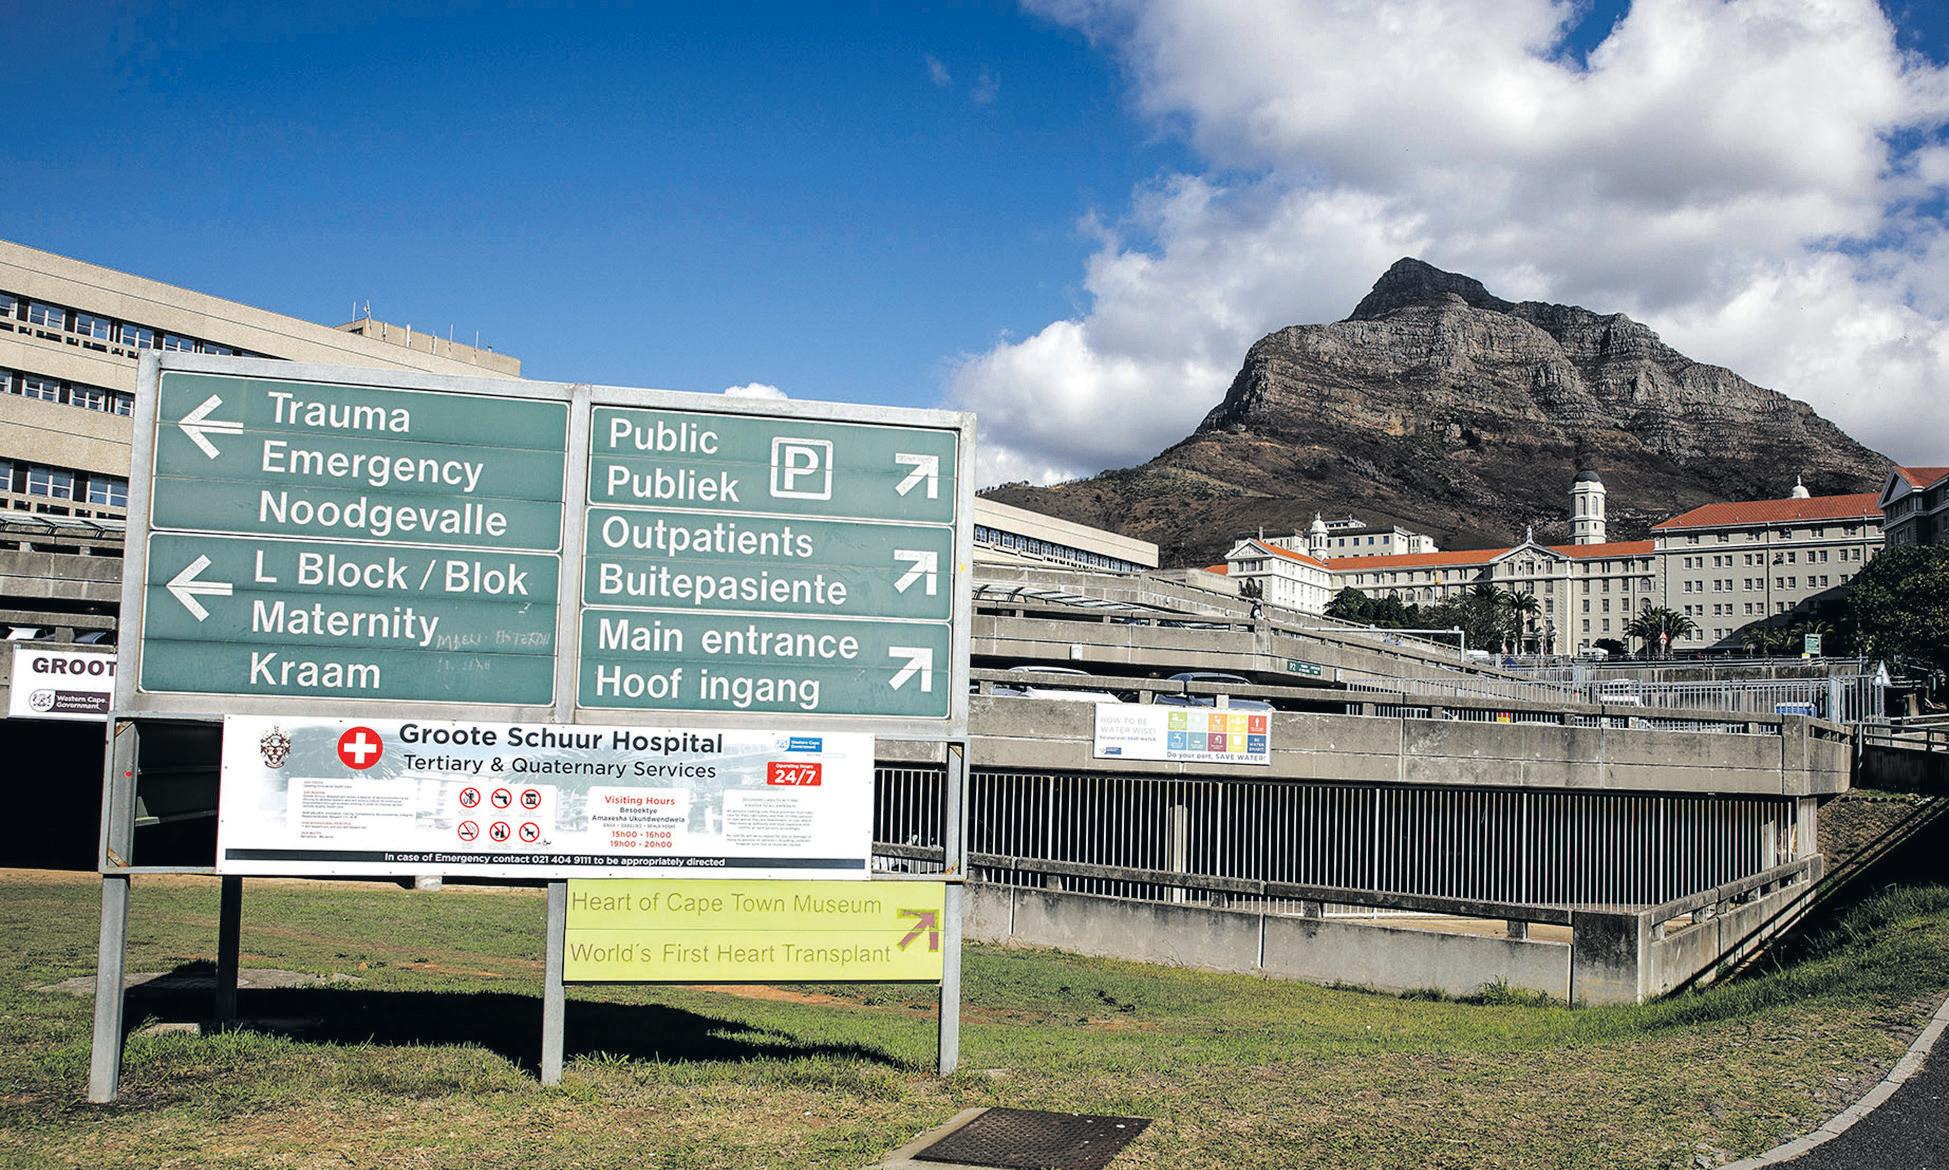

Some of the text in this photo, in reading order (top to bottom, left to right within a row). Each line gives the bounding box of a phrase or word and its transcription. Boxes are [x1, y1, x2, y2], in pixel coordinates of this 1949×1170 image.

[268, 391, 410, 433] Trauma
[609, 417, 719, 454] Public
[261, 440, 484, 493] Emergency
[783, 445, 820, 491] P
[607, 465, 740, 503] Publiek
[259, 490, 508, 537] Noodgevalle
[602, 515, 814, 559] Outpatients
[255, 550, 529, 597] L Block / Blok
[600, 562, 848, 606] Buitepasiente
[252, 600, 440, 647] Maternity
[599, 618, 860, 660] Main entrance
[32, 657, 117, 677] GROOT
[250, 651, 381, 690] Kraam
[56, 695, 86, 703] Western
[596, 664, 820, 710] Hoof ingang
[56, 702, 100, 710] Government
[1100, 726, 1131, 735] WATER
[1101, 716, 1148, 726] HOW TO BE
[399, 723, 723, 756] Groote Schuur Hospital
[404, 754, 717, 778] Tertiary & Quaternary Services
[1236, 754, 1267, 762] WATER!
[774, 769, 817, 786] 24/7
[604, 795, 676, 806] Visiting Hours
[610, 840, 637, 848] 19h00
[644, 840, 673, 848] 20h00
[611, 830, 638, 838] 15h00
[645, 831, 672, 839] 16h00
[384, 852, 726, 868] In case of Emergency contact 021 404 9111 to be appropriately directed
[571, 892, 882, 916] Heart of Cape Town Museum
[663, 943, 709, 963] First
[717, 944, 774, 964] Heart
[780, 944, 891, 967] Transplant
